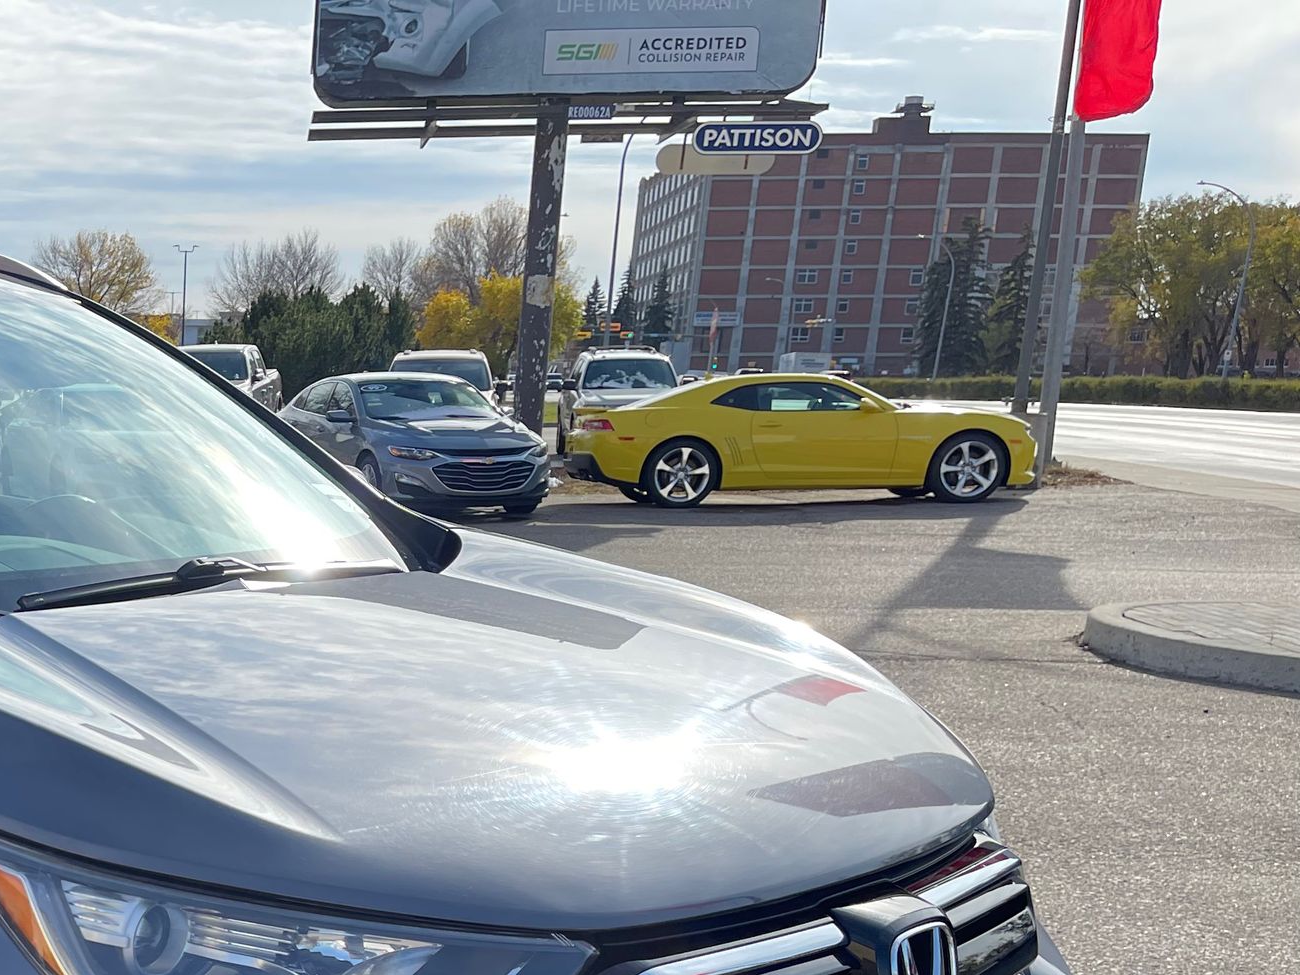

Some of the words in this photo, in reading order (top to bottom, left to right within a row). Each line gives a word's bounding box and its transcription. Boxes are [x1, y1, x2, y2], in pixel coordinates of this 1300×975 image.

[556, 0, 640, 13] LIFETIME
[645, 0, 753, 11] WARRANTY
[639, 37, 747, 50] ACCREDITED
[638, 52, 701, 63] COLLISION
[706, 52, 745, 62] REPAIR
[703, 128, 813, 147] PATTISON
